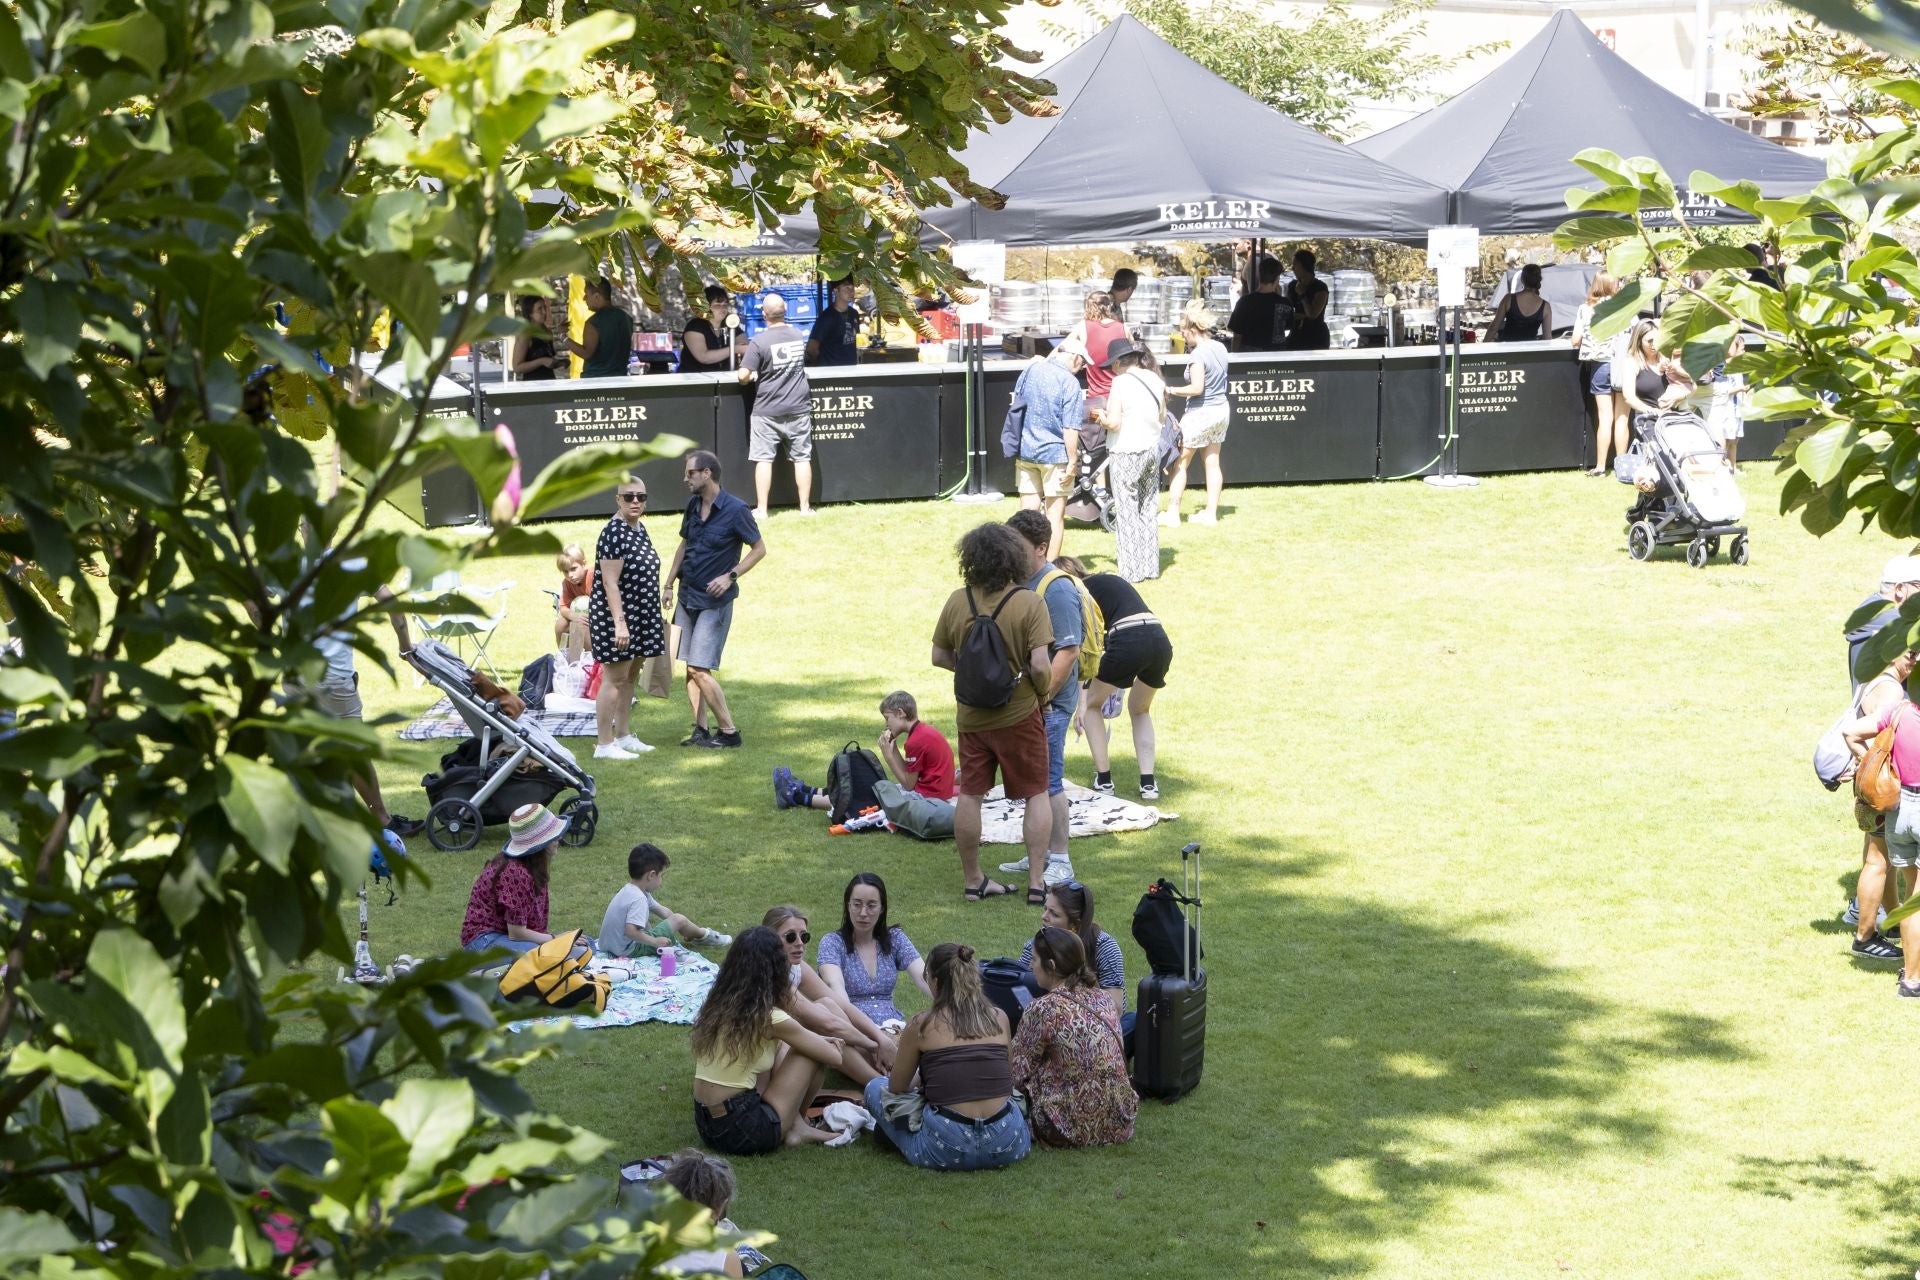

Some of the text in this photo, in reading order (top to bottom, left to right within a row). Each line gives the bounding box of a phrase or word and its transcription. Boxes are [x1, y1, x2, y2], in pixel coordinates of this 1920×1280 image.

[1157, 201, 1271, 221] KELER
[1693, 209, 1717, 217] 1872
[1170, 220, 1260, 231] DONOSTIA 1872
[1229, 379, 1315, 394] KELER
[1458, 386, 1498, 394] ONOSTIA
[810, 396, 874, 411] ELER
[1458, 396, 1519, 405] ARAGARDOA
[1236, 405, 1307, 414] GARAGARDOA
[1460, 405, 1508, 414] CERVEZA
[555, 406, 647, 424] KELER
[1247, 414, 1296, 422] CERVEZA
[565, 423, 615, 431] DONOSTIA
[811, 422, 866, 432] AGARDOA
[563, 433, 639, 443] GARAGARDOA
[811, 432, 855, 440] ERVEZA
